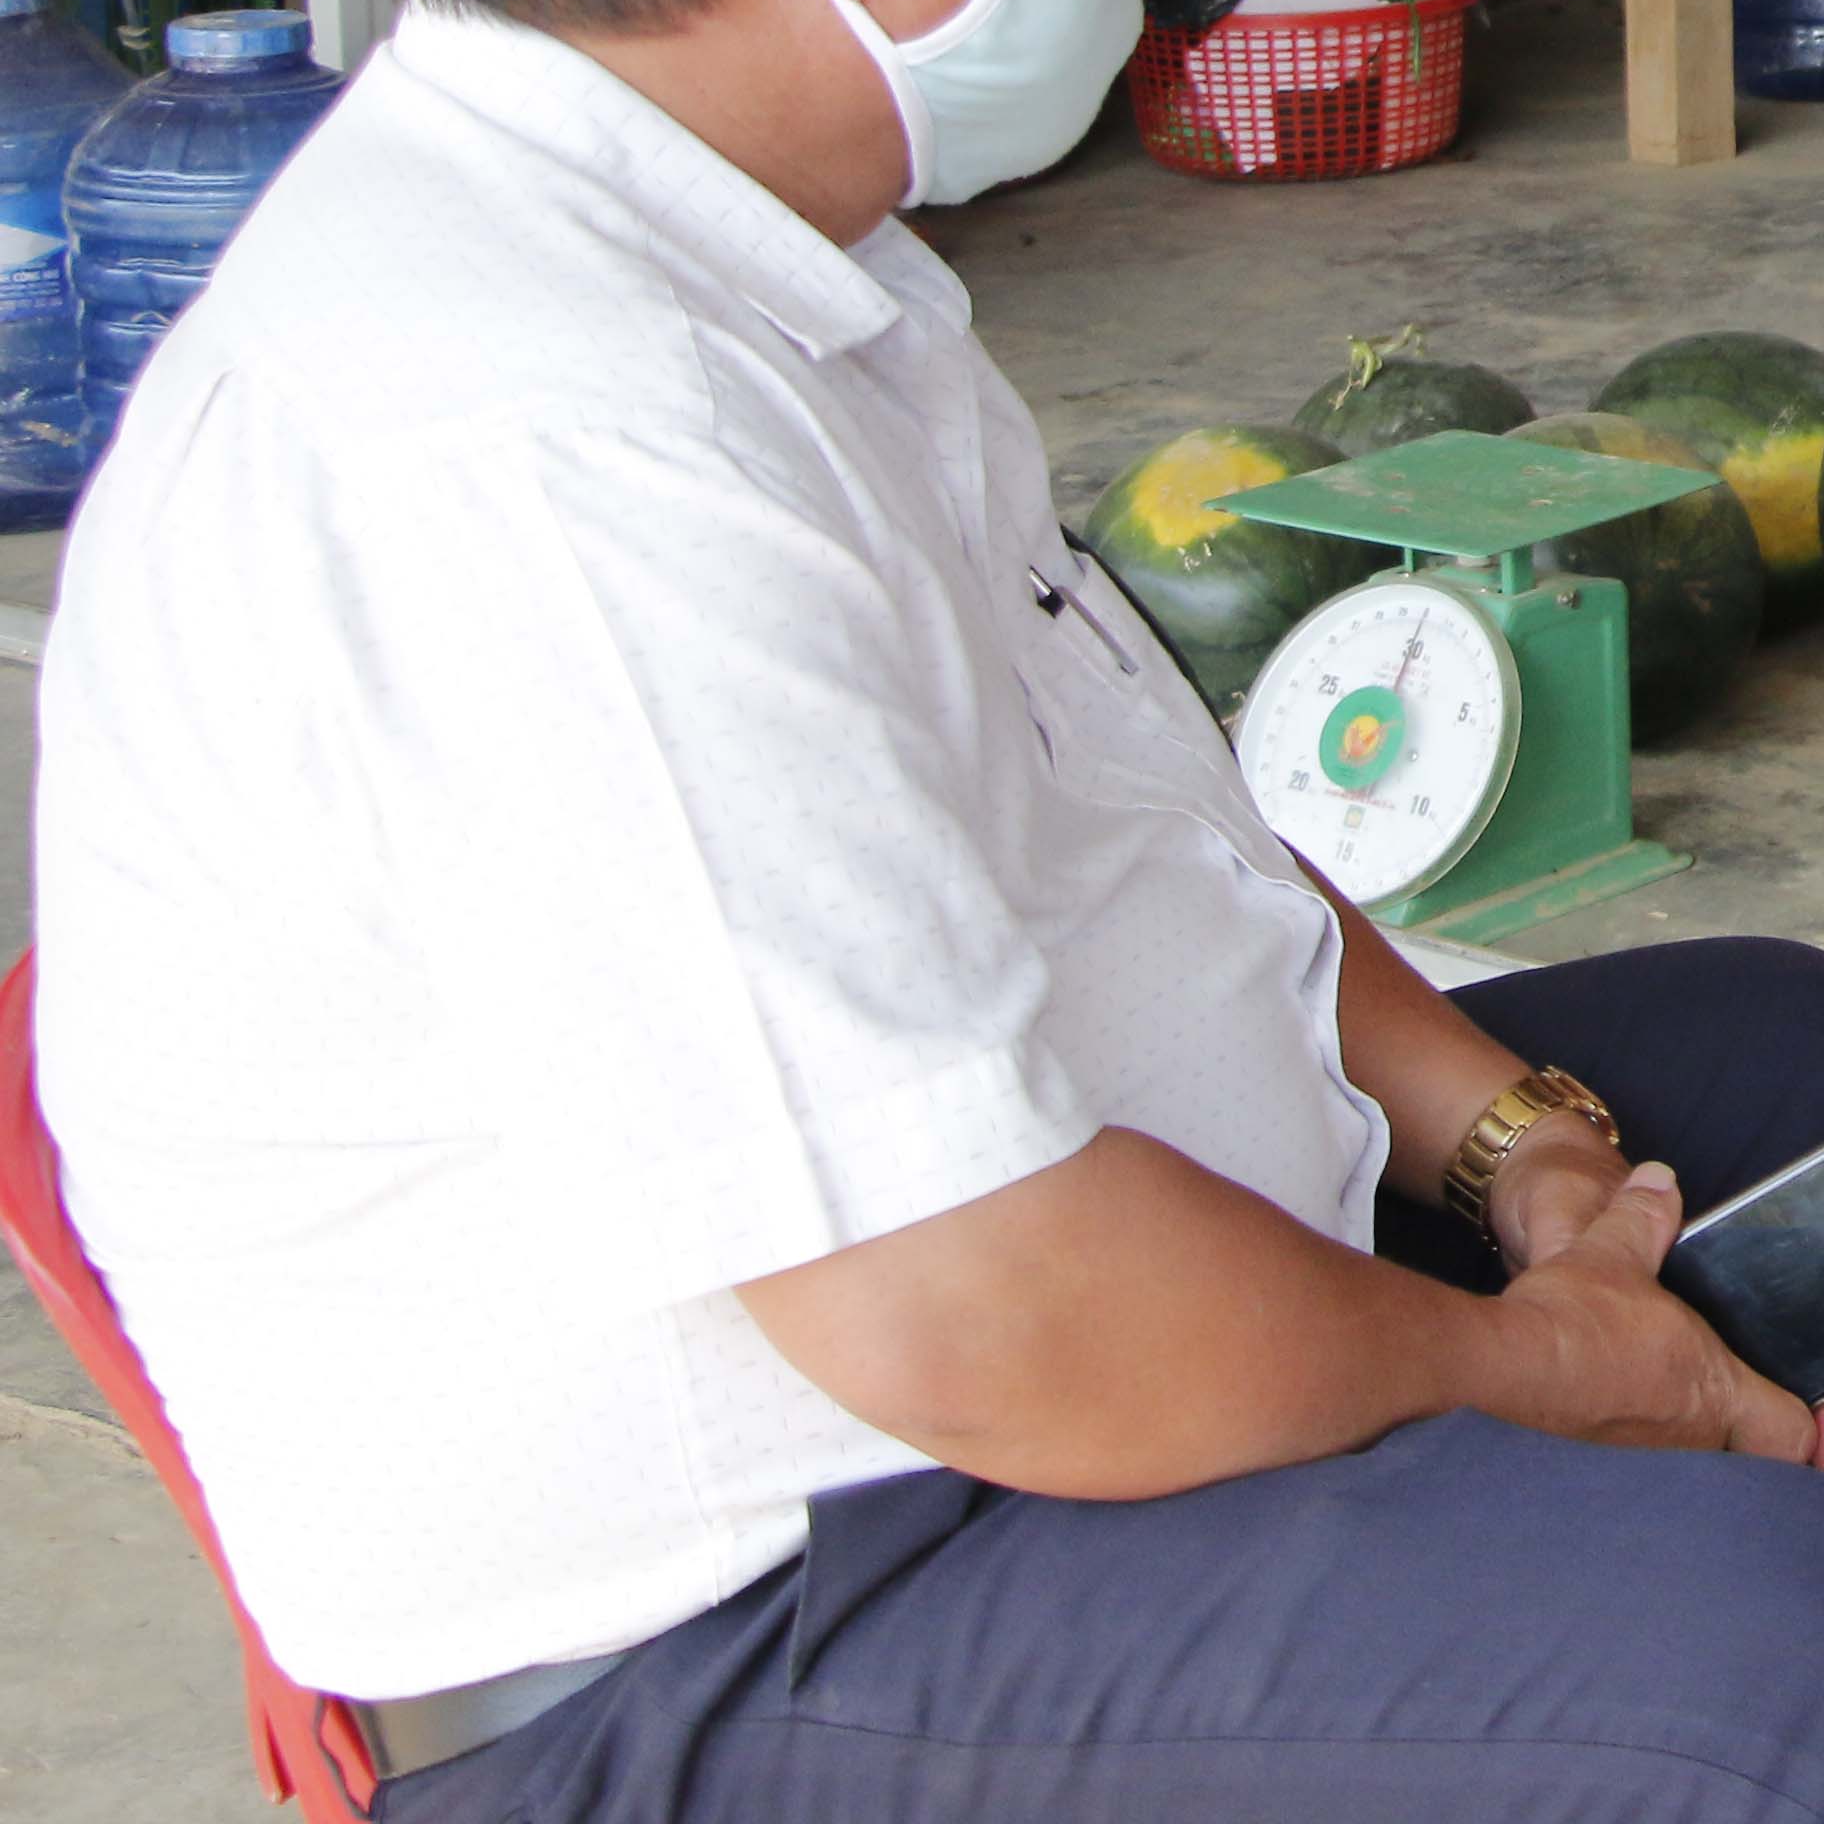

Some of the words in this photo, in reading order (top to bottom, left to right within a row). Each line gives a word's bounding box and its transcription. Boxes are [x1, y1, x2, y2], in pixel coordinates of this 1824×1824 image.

[1403, 639, 1424, 660] 30
[1318, 673, 1339, 696] 25
[1458, 702, 1471, 723] 5
[1288, 770, 1309, 792] 20
[1410, 794, 1430, 816] 10
[1335, 841, 1356, 863] 15
